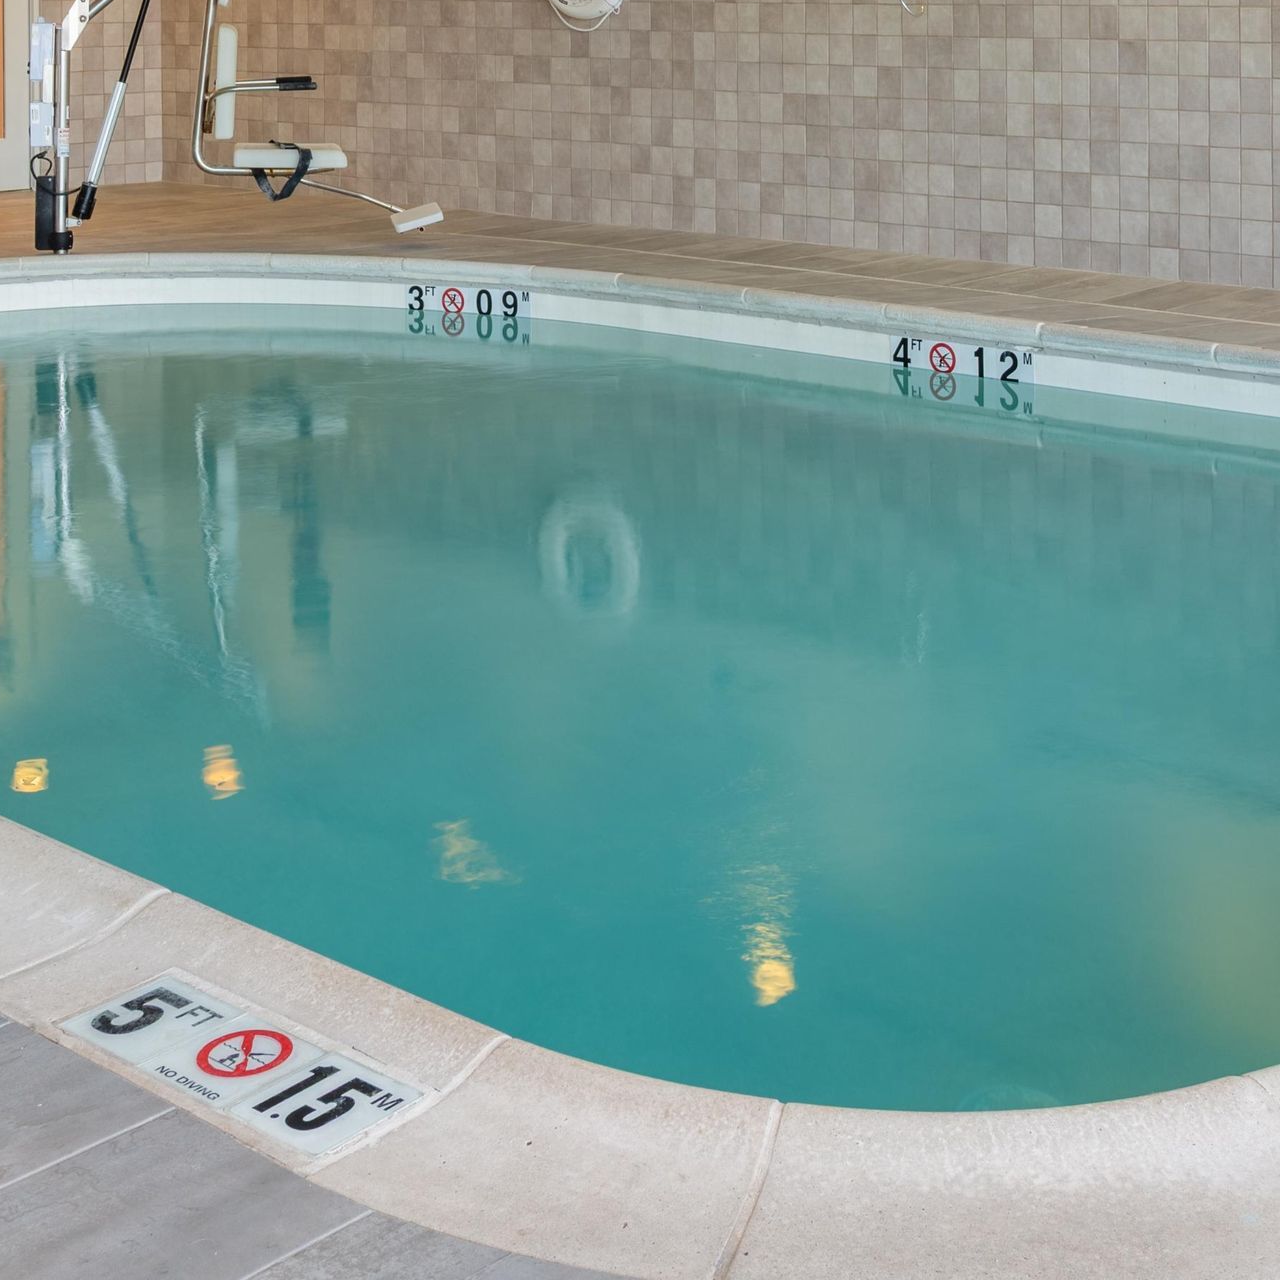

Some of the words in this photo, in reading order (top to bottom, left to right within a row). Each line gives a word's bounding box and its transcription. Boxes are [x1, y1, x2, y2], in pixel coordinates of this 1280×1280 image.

[1023, 353, 1032, 365] M
[91, 986, 193, 1035] 5
[176, 1005, 224, 1028] FT
[155, 1065, 178, 1080] NO
[176, 1074, 221, 1102] DIVING
[251, 1065, 384, 1131] 1.5
[373, 1092, 405, 1112] M
